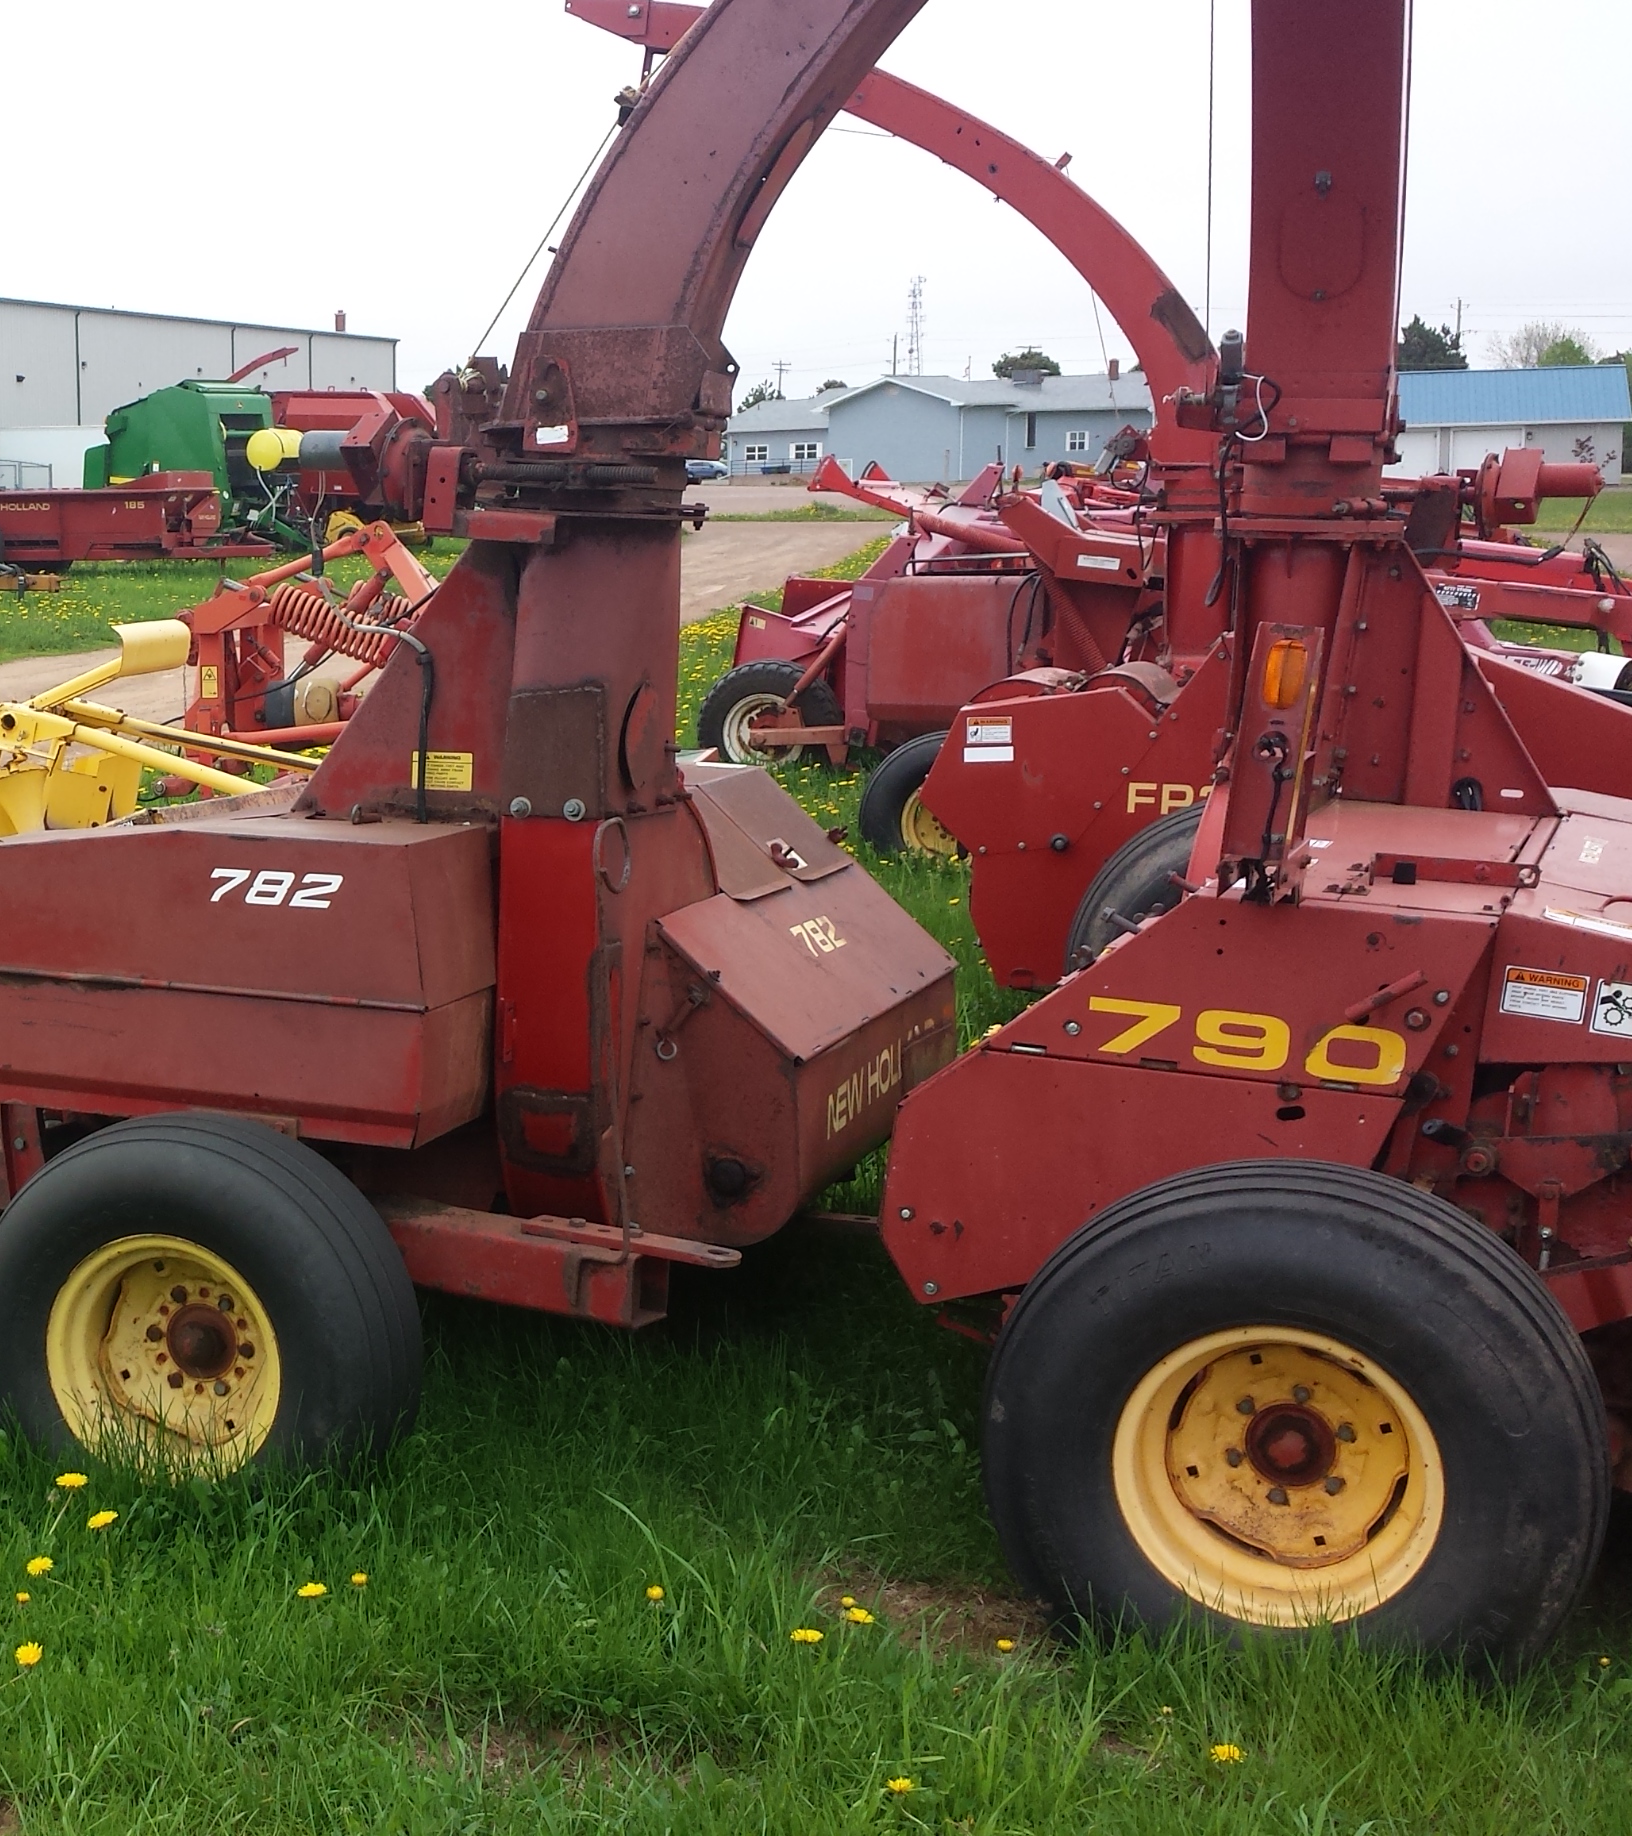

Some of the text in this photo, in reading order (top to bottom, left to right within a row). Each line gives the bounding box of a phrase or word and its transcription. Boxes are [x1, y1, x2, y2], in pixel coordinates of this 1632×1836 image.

[0, 503, 50, 511] HOLLAND
[124, 501, 145, 510] 185
[210, 867, 344, 909] 782
[789, 915, 847, 957] 782
[1528, 973, 1580, 988] WARNING
[1089, 996, 1407, 1086] 790
[826, 1067, 864, 1140] NEW
